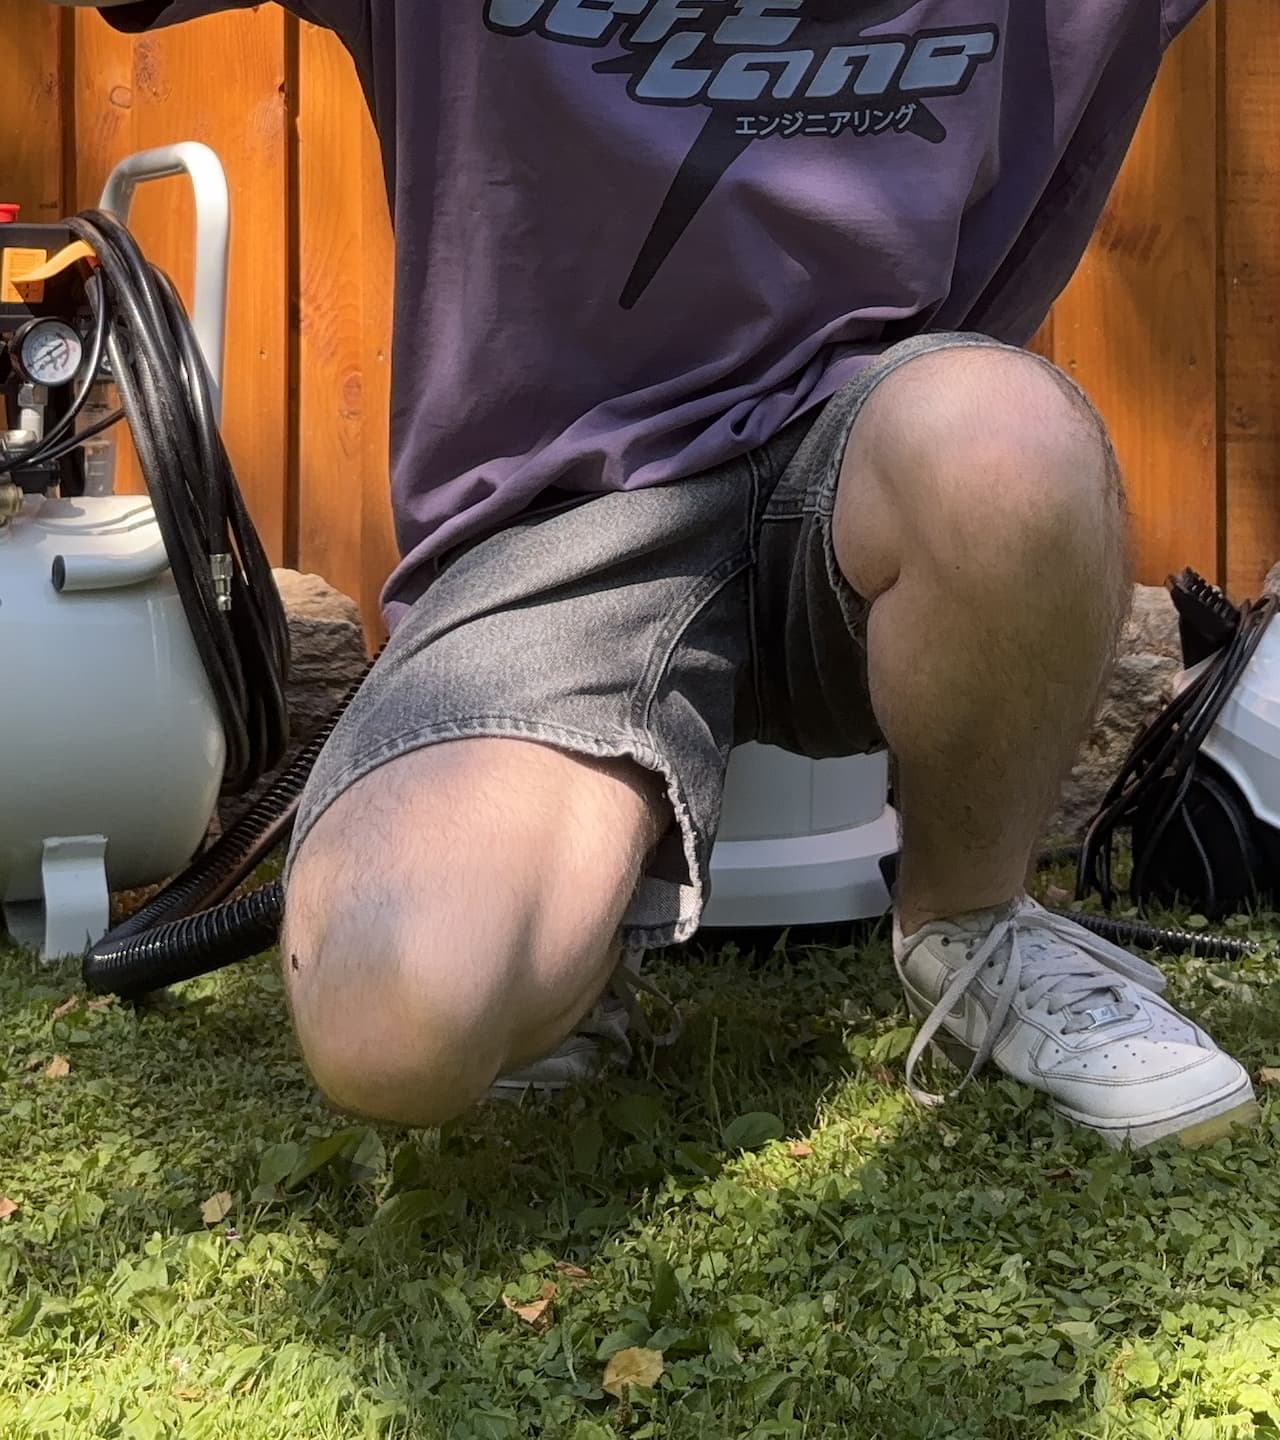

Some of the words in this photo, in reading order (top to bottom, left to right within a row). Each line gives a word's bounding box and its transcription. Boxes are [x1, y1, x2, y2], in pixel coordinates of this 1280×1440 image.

[734, 103, 917, 136] エンジニアリング
